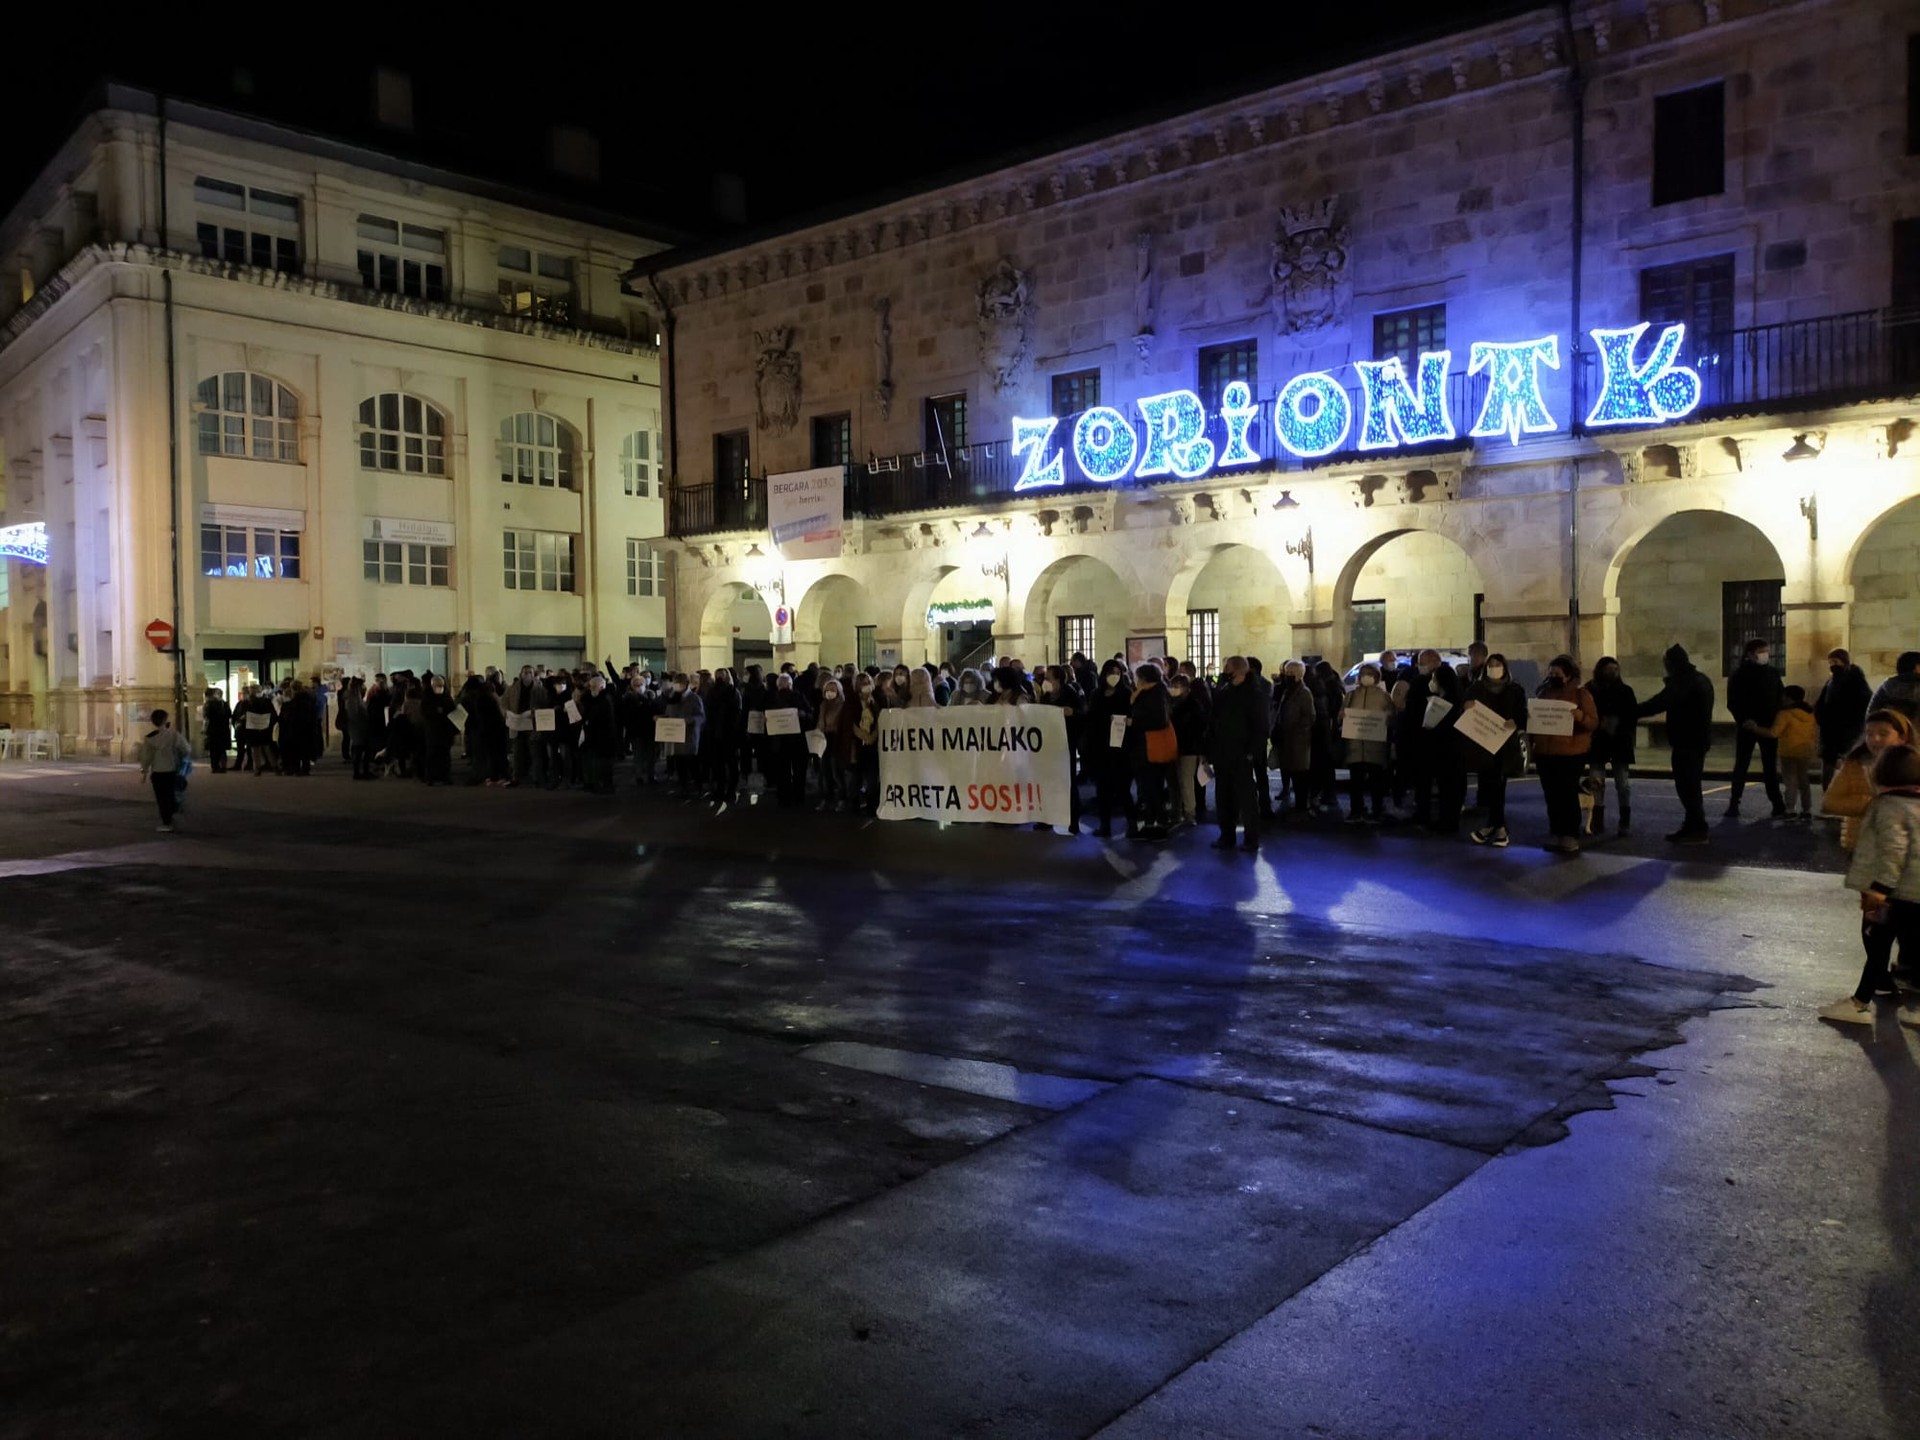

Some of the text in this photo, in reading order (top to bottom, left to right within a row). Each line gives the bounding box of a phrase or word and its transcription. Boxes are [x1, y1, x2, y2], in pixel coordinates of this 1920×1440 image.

[773, 481, 809, 494] BERGARA
[942, 726, 1043, 753] MAILAKO
[967, 783, 1044, 812] SOS!!!
